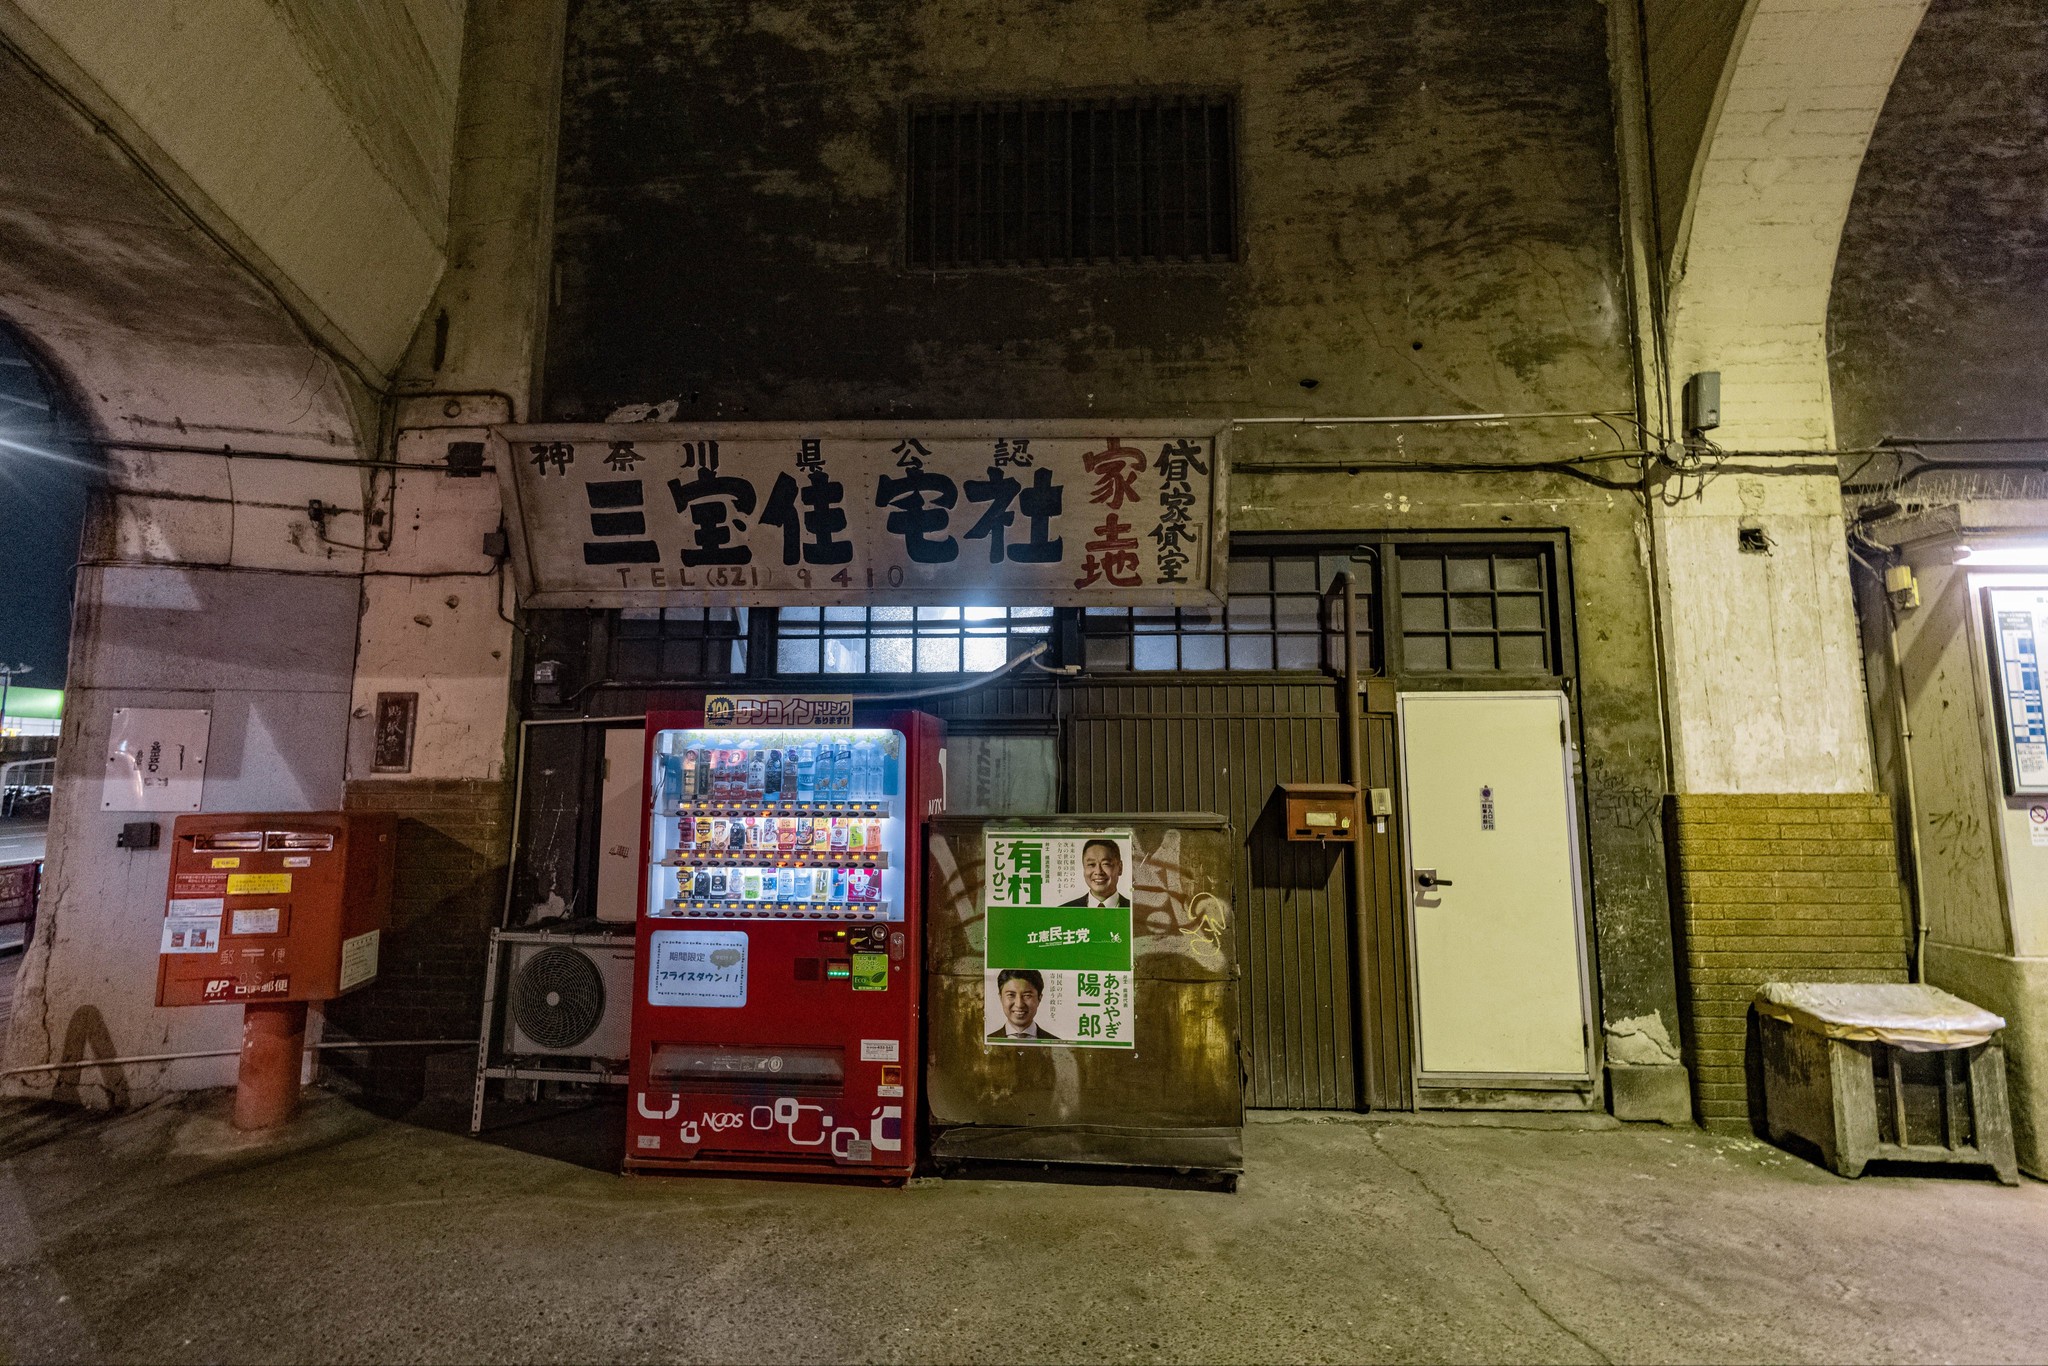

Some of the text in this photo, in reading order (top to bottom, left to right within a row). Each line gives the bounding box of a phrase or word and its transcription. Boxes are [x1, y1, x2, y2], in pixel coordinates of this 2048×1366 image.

[530, 438, 1034, 476] 神奈川県公認
[583, 466, 1063, 566] 三宝住宅社
[1148, 439, 1208, 585] 貸家貸室
[736, 698, 850, 725] ワンコイン ドリンク
[993, 841, 1006, 901] としひこ
[1008, 841, 1042, 904] 有村
[669, 951, 706, 963] 期間限定
[1027, 926, 1090, 945] 立憲民主党
[1077, 973, 1101, 1038] 陽一郎
[1103, 973, 1122, 1039] あおやぎ
